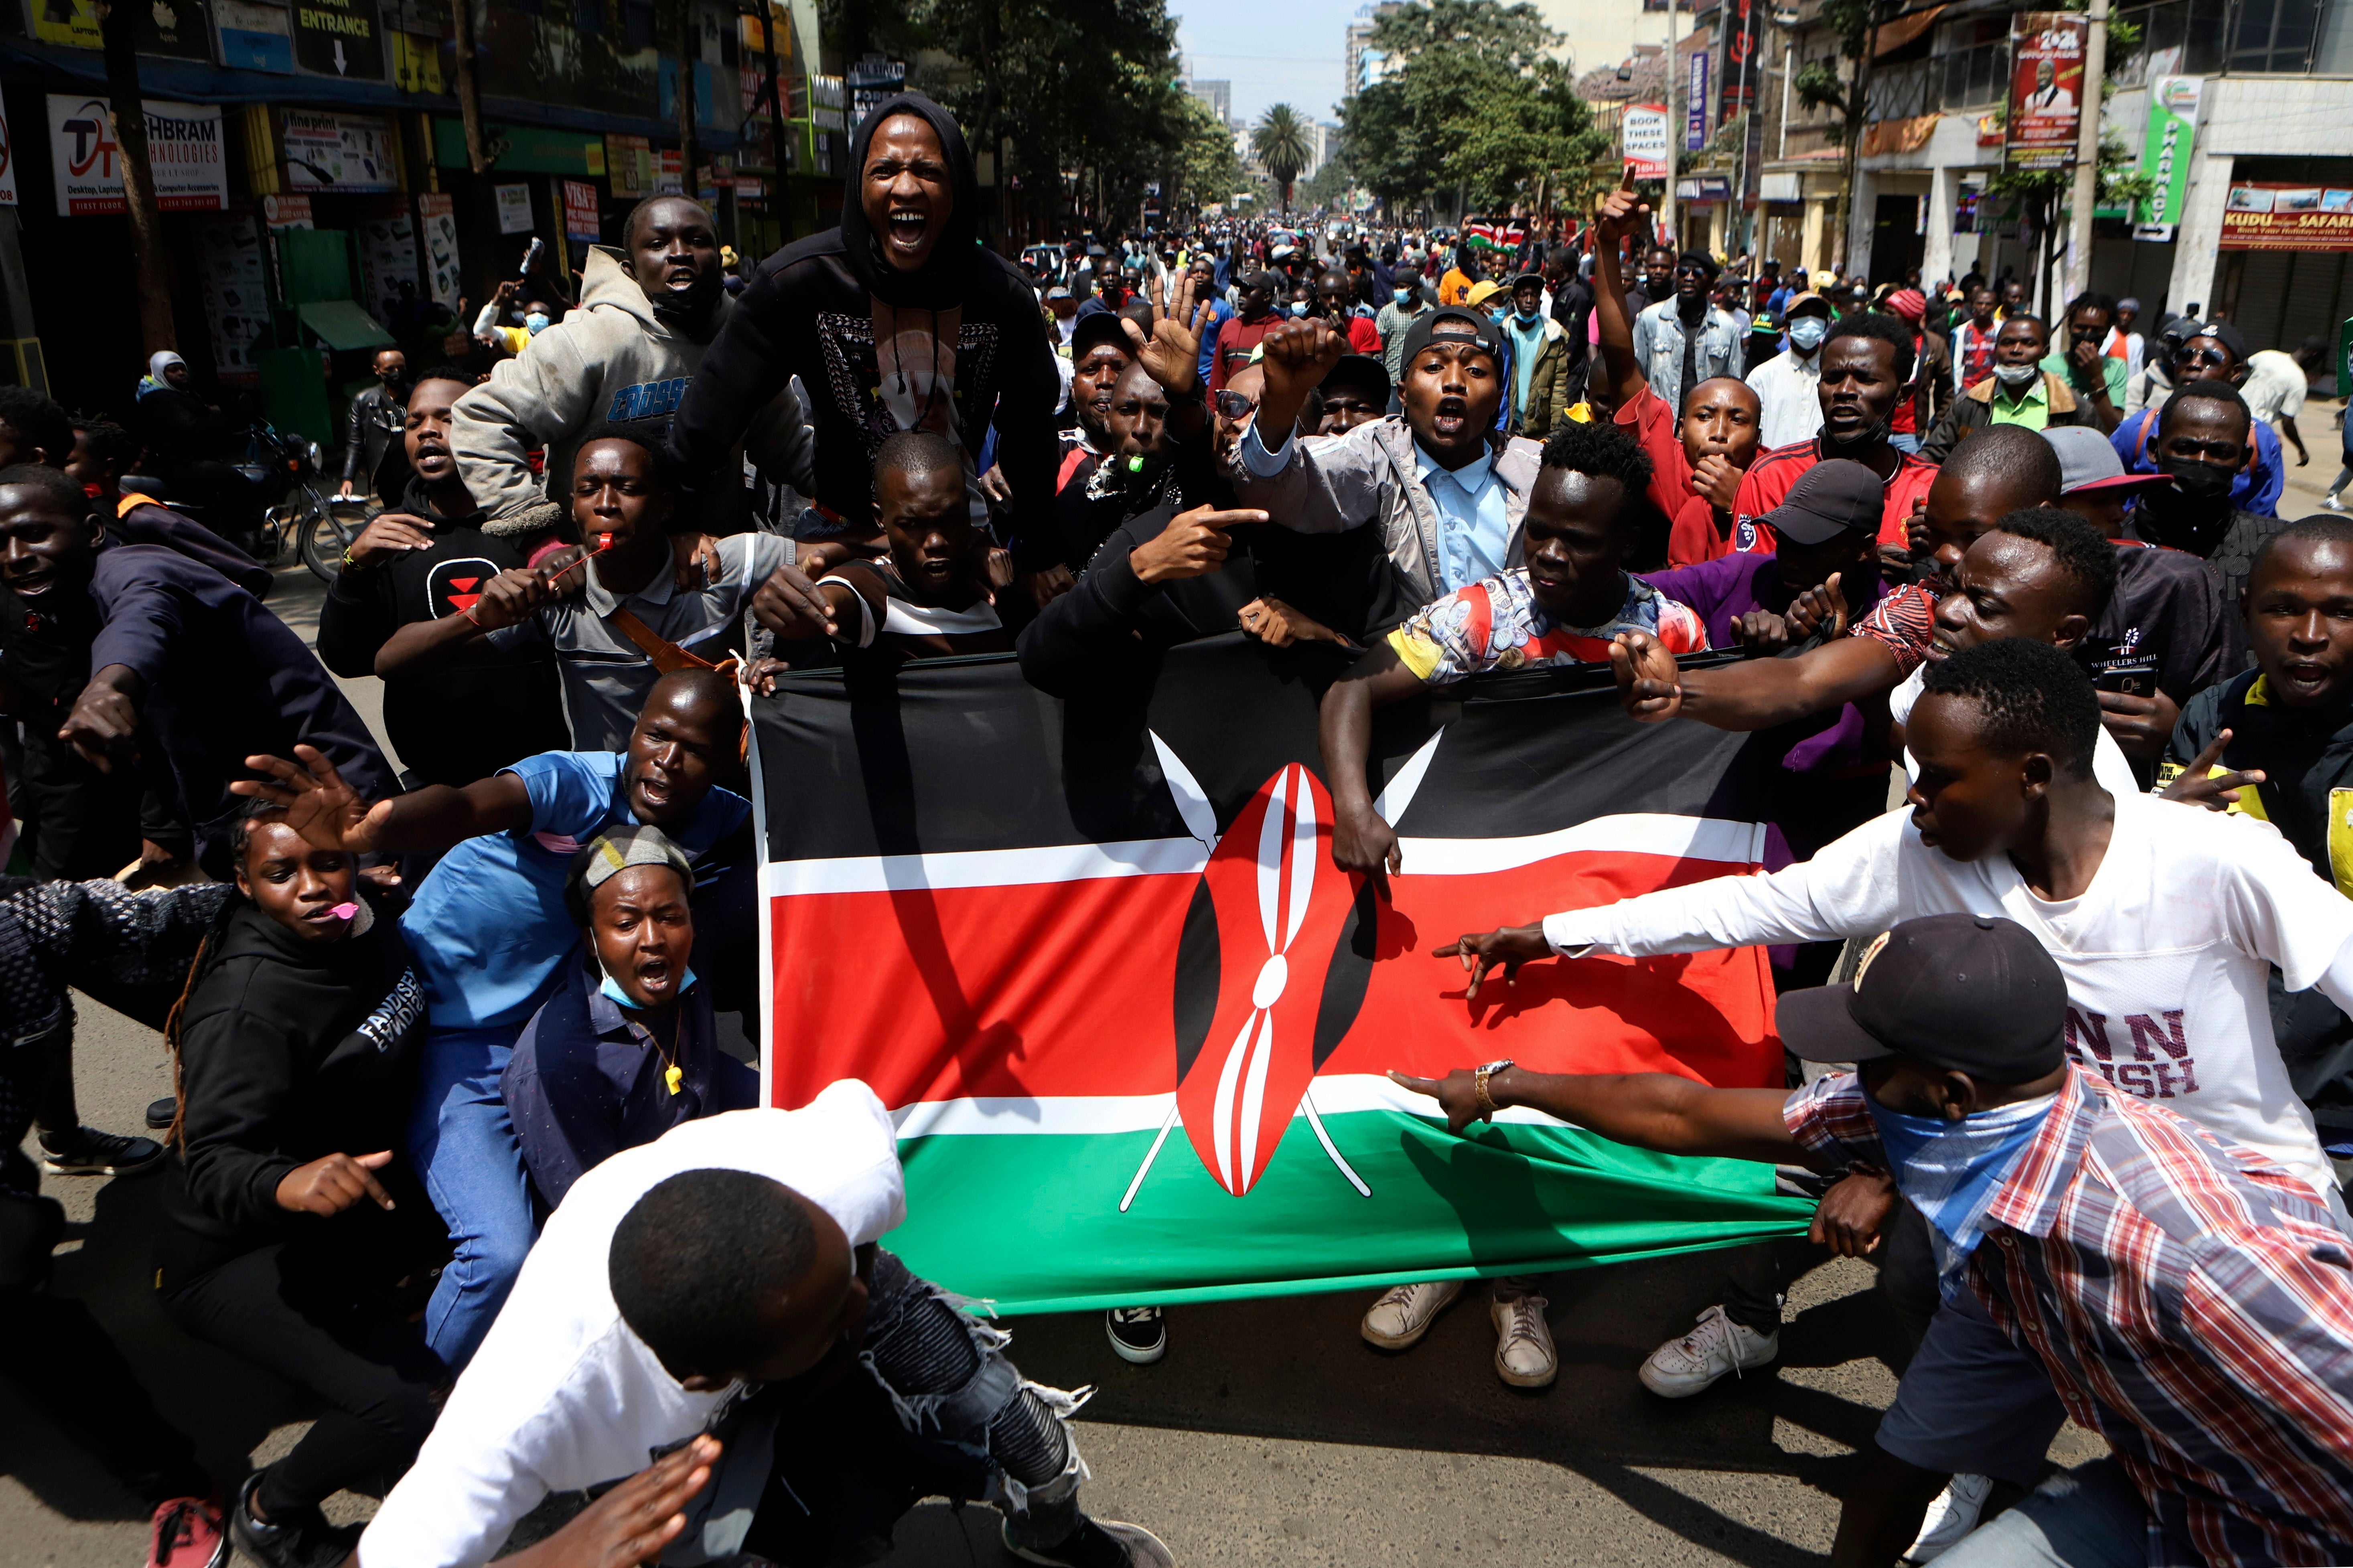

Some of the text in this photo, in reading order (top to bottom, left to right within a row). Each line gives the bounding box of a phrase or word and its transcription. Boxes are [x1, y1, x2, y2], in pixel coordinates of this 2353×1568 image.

[299, 7, 371, 38] ENTRANCE
[72, 26, 99, 36] LAPTOPS
[160, 32, 178, 43] Apple
[1630, 116, 1661, 126] BOOK
[144, 117, 216, 141] HBRAM
[1627, 128, 1662, 138] THESE
[1625, 141, 1666, 151] SPACES
[150, 142, 218, 163] HNOLOGIES
[2150, 121, 2179, 225] PHARMACY
[68, 185, 98, 195] Desktop,
[159, 185, 186, 193] Computer
[564, 183, 590, 209] VISA
[76, 202, 97, 211] FIRST
[2224, 212, 2275, 227] KUDU
[2091, 654, 2158, 668] WHEELERS HILL
